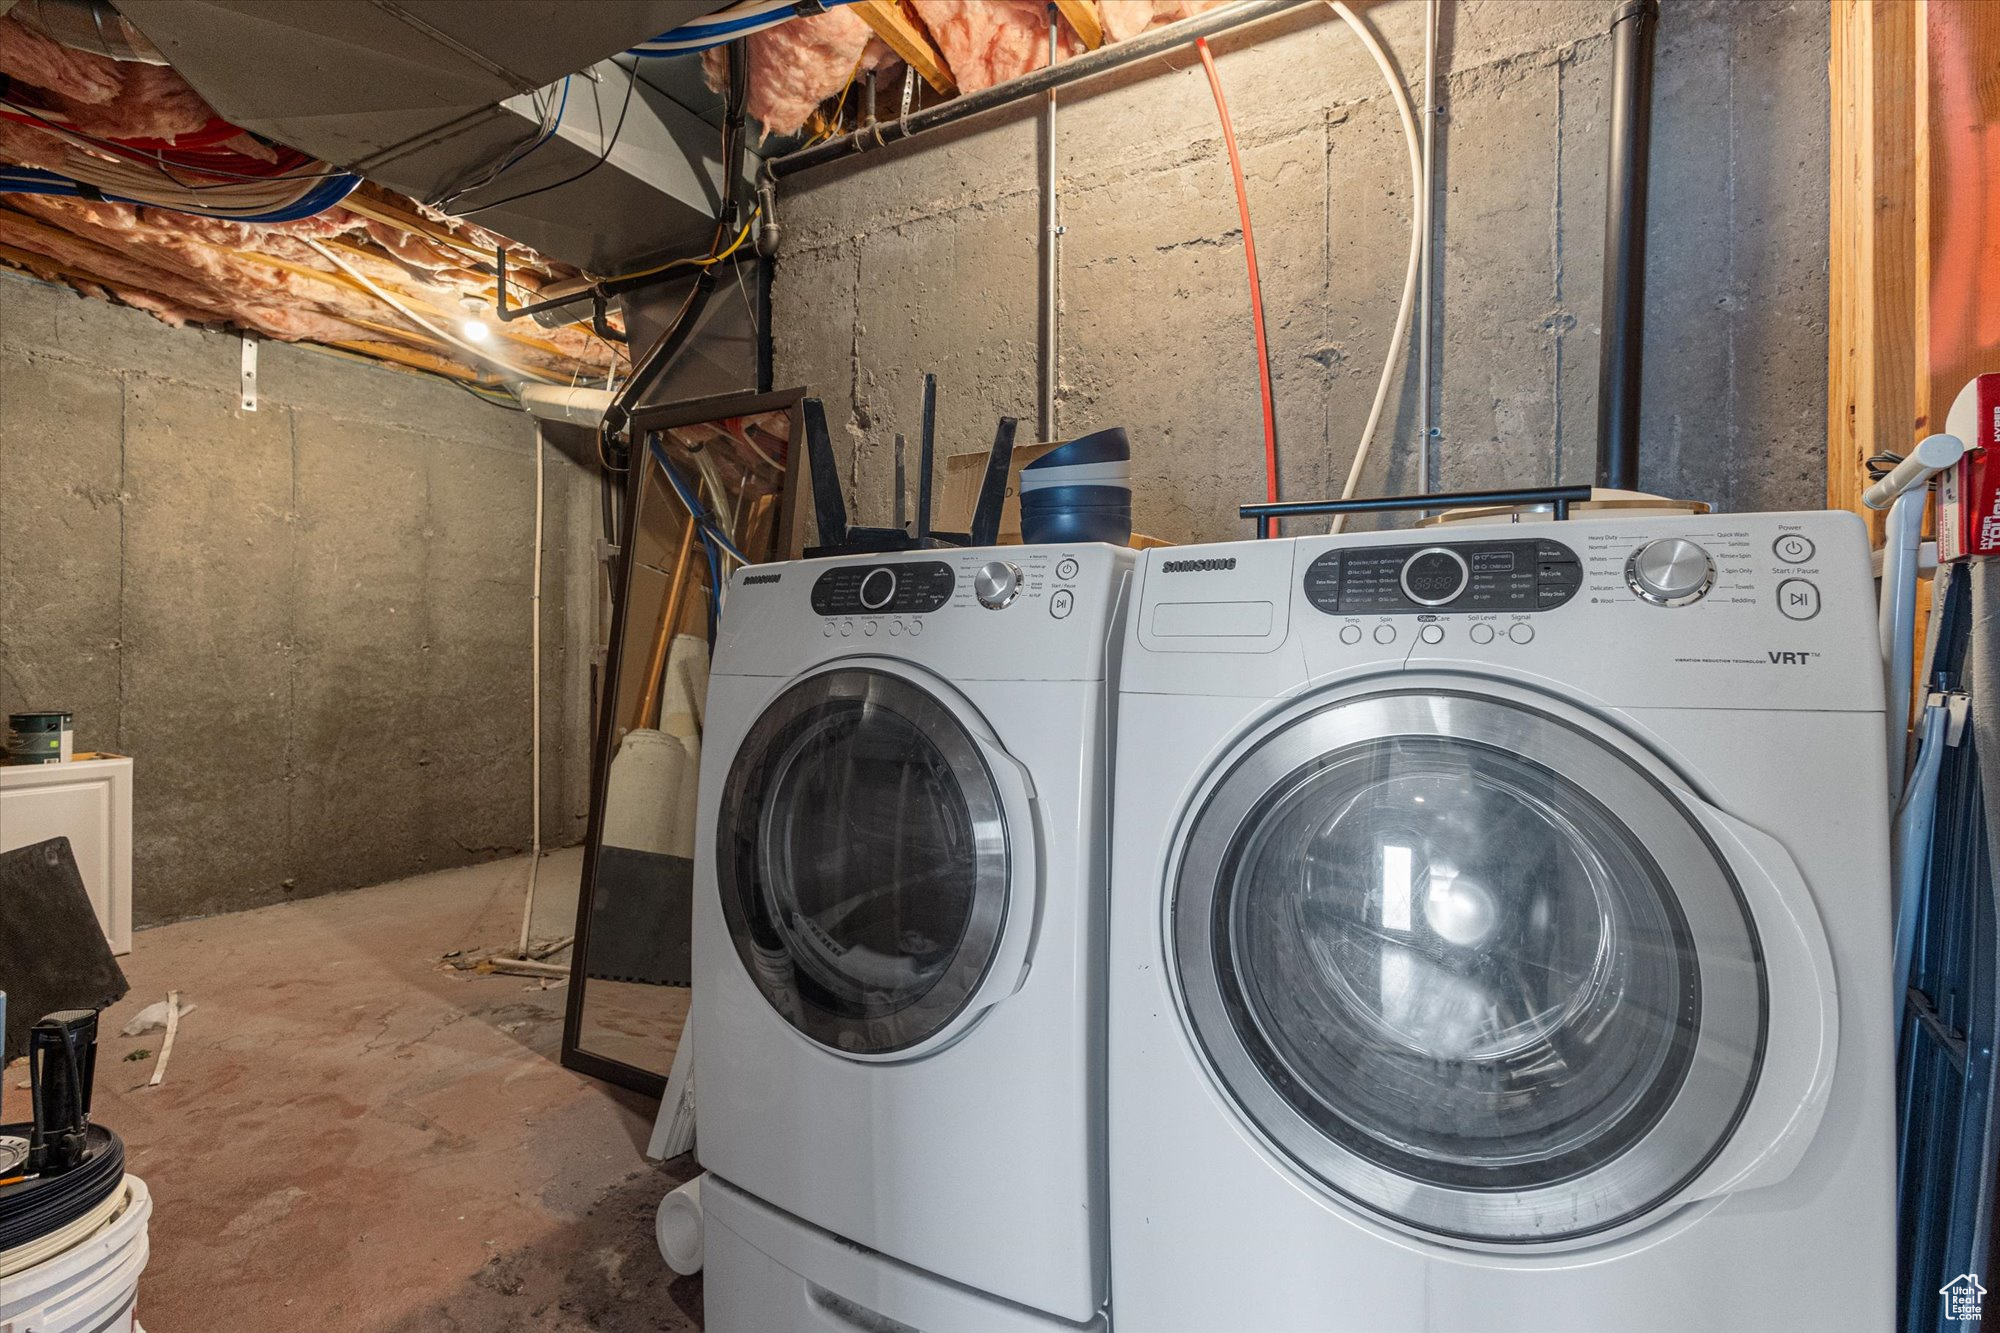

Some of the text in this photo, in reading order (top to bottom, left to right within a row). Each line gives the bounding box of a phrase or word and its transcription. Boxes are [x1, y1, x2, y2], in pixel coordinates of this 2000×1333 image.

[1979, 515, 1992, 550] HYPER
[1162, 558, 1237, 574] SAMSUNG
[743, 574, 782, 586] SAMSUNG
